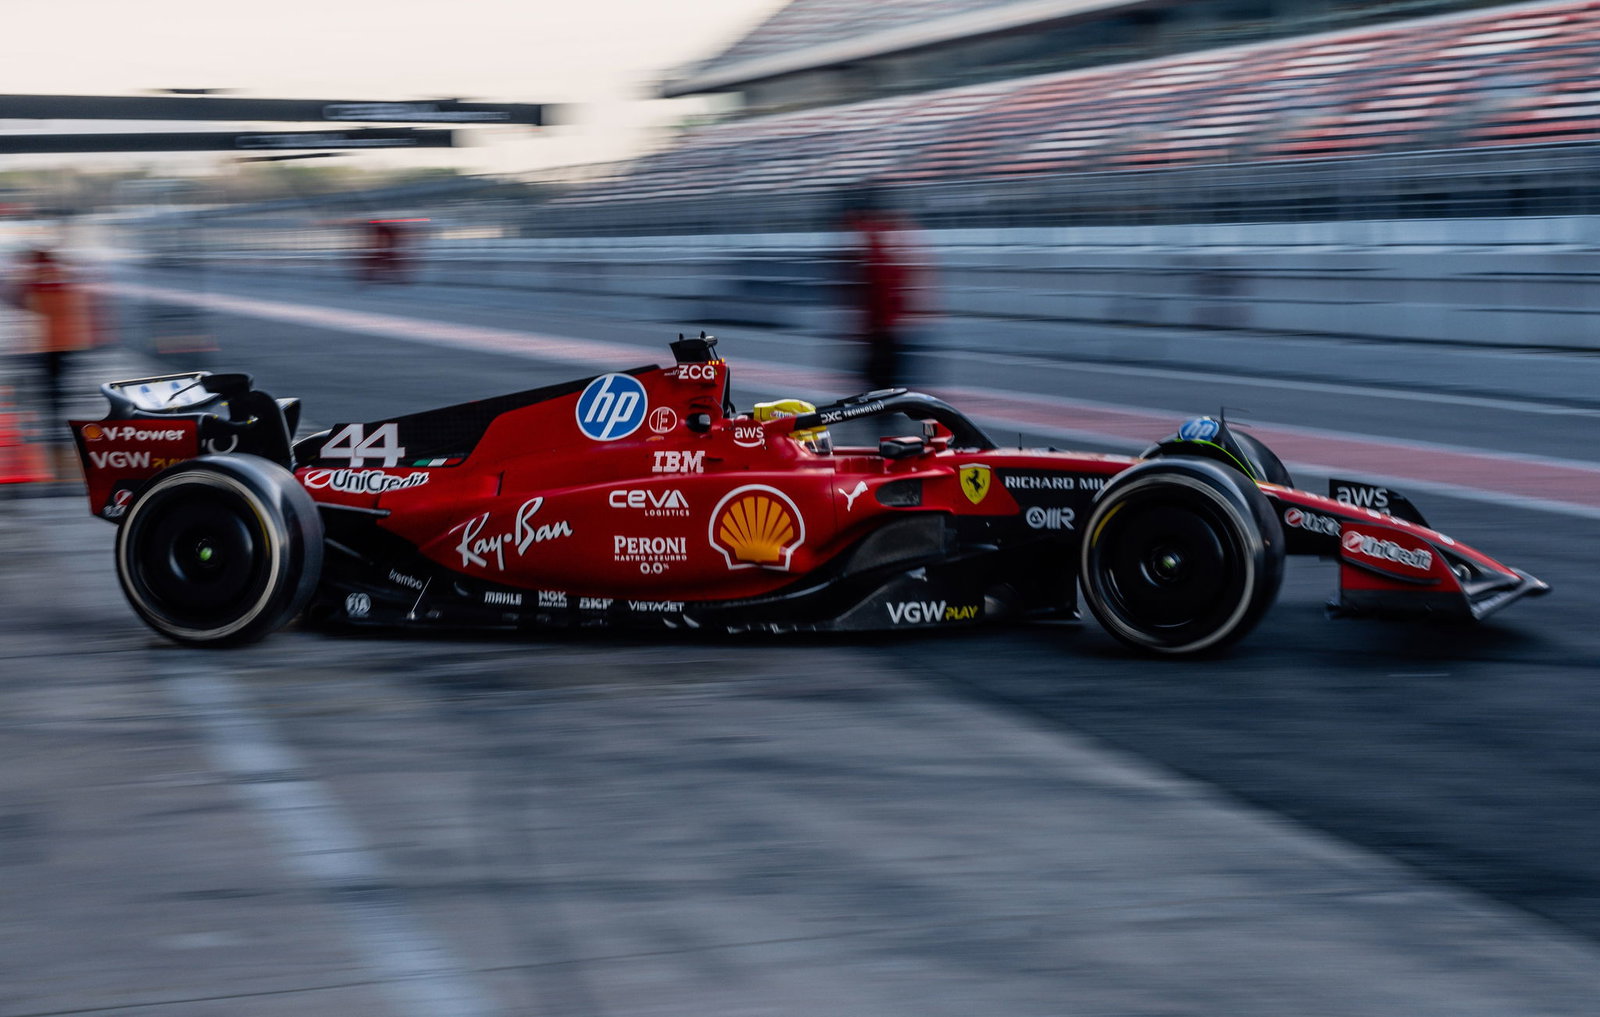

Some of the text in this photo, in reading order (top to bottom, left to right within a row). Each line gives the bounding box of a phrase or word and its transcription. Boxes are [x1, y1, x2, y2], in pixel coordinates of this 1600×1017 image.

[678, 364, 715, 380] ZCG
[584, 374, 641, 441] hp
[820, 401, 885, 425] DXC TECHNOLOGY
[102, 426, 185, 441] V-Power
[734, 426, 765, 440] aws
[320, 423, 406, 468] 44
[89, 451, 151, 469] VGW
[651, 450, 706, 473] IBM
[331, 470, 430, 494] UniCredit
[1004, 476, 1106, 490] RICHARD MIL
[609, 489, 689, 508] CEVA
[1336, 486, 1389, 508] aws
[644, 509, 690, 517] LOGISTICS
[613, 535, 687, 554] PERONI
[388, 568, 423, 590] brembo
[484, 591, 522, 606] MAHLE
[886, 600, 978, 624] VGW PLAY
